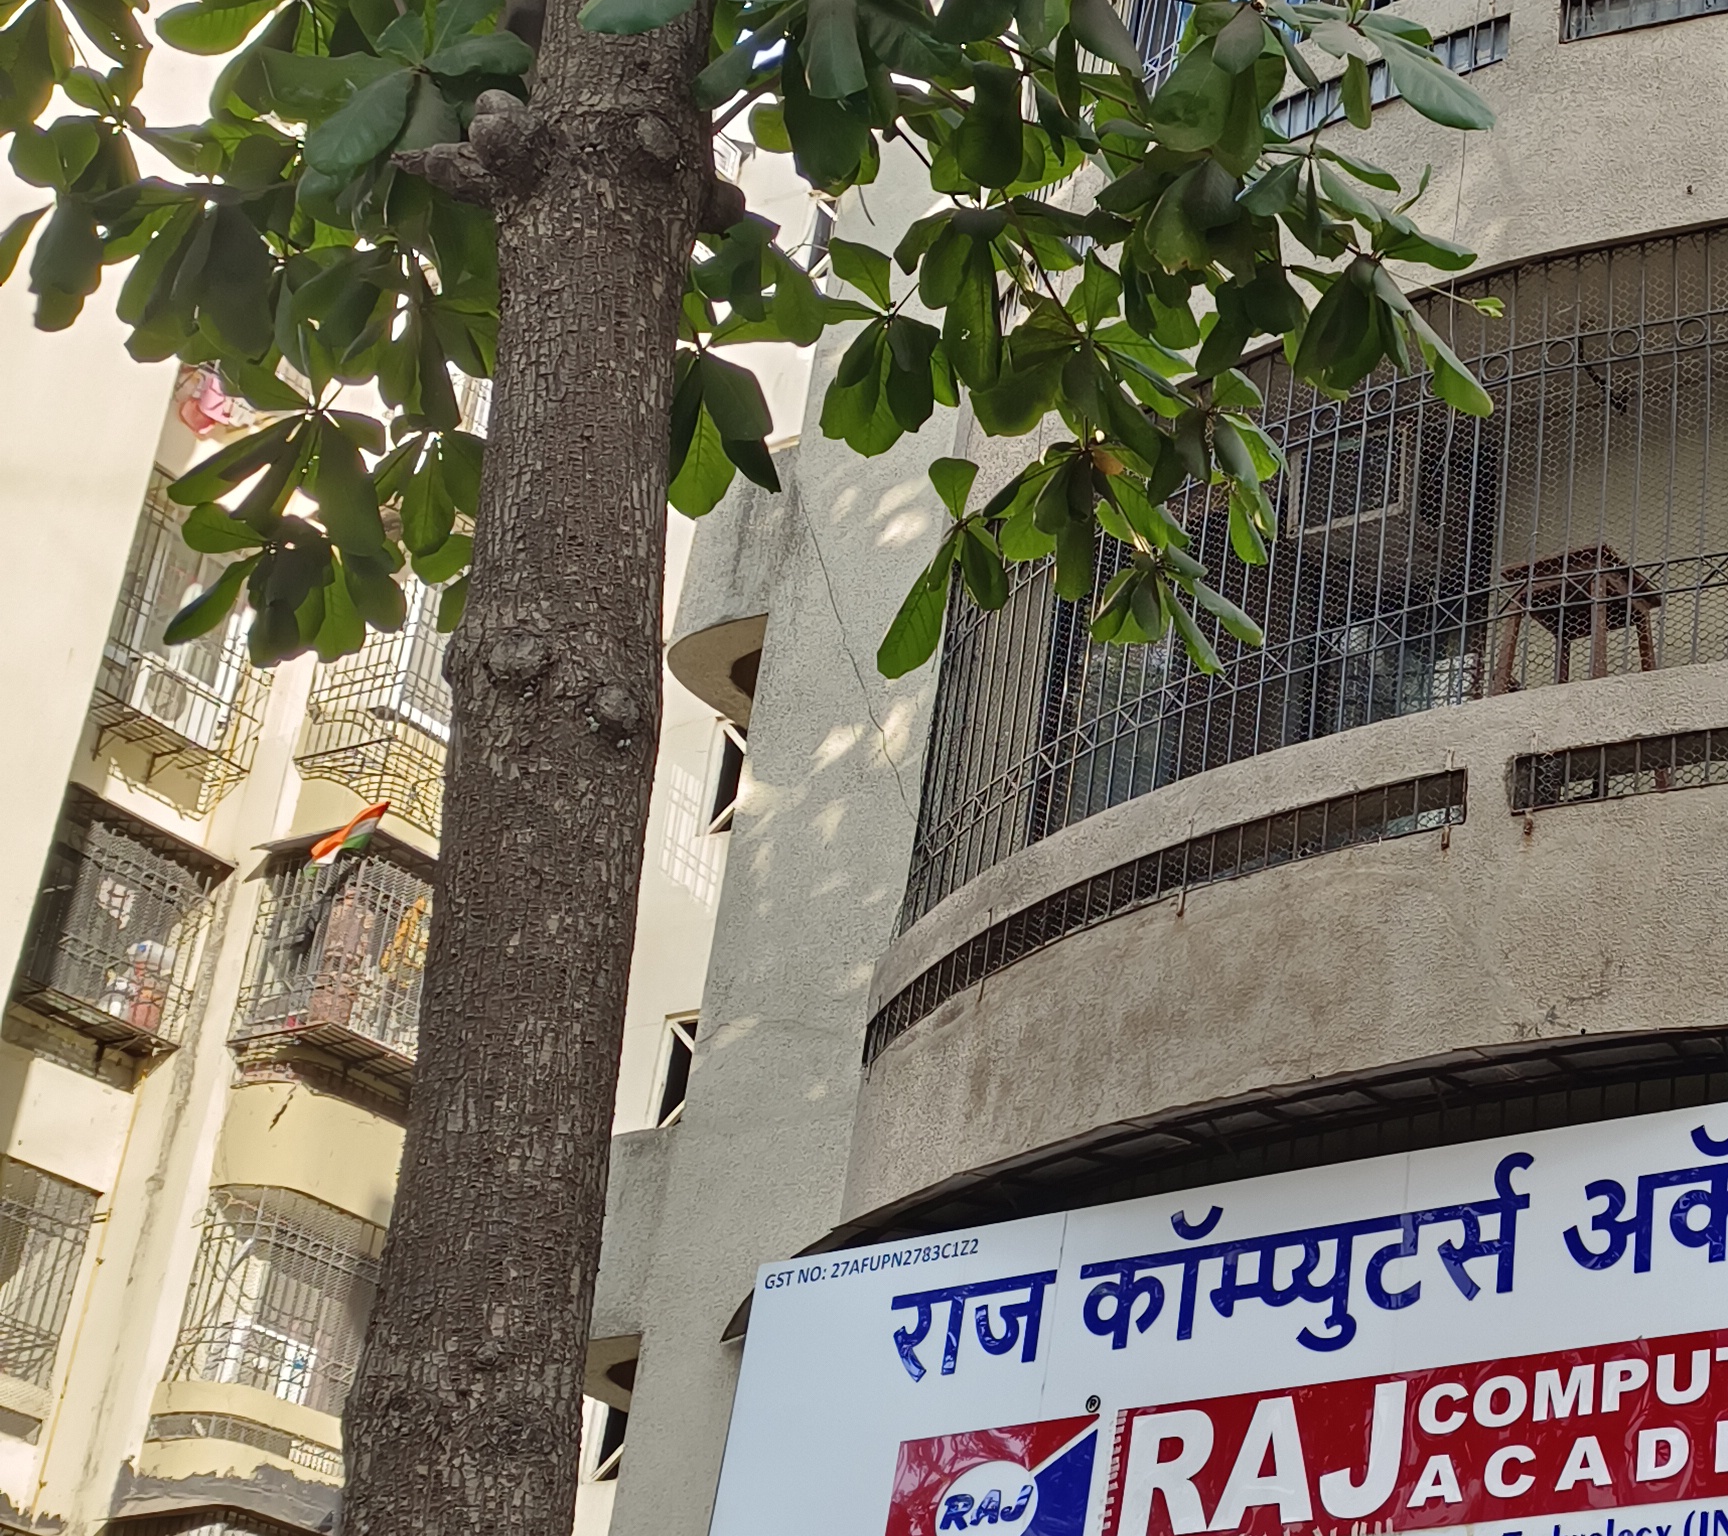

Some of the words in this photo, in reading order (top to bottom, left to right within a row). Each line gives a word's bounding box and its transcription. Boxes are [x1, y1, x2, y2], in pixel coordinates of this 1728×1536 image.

[764, 1270, 795, 1290] GST
[797, 1265, 827, 1285] NO:
[831, 1238, 980, 1279] 27AFUPN2783C1Z2
[889, 1269, 1058, 1383] राज
[939, 1484, 1034, 1531] RAJ
